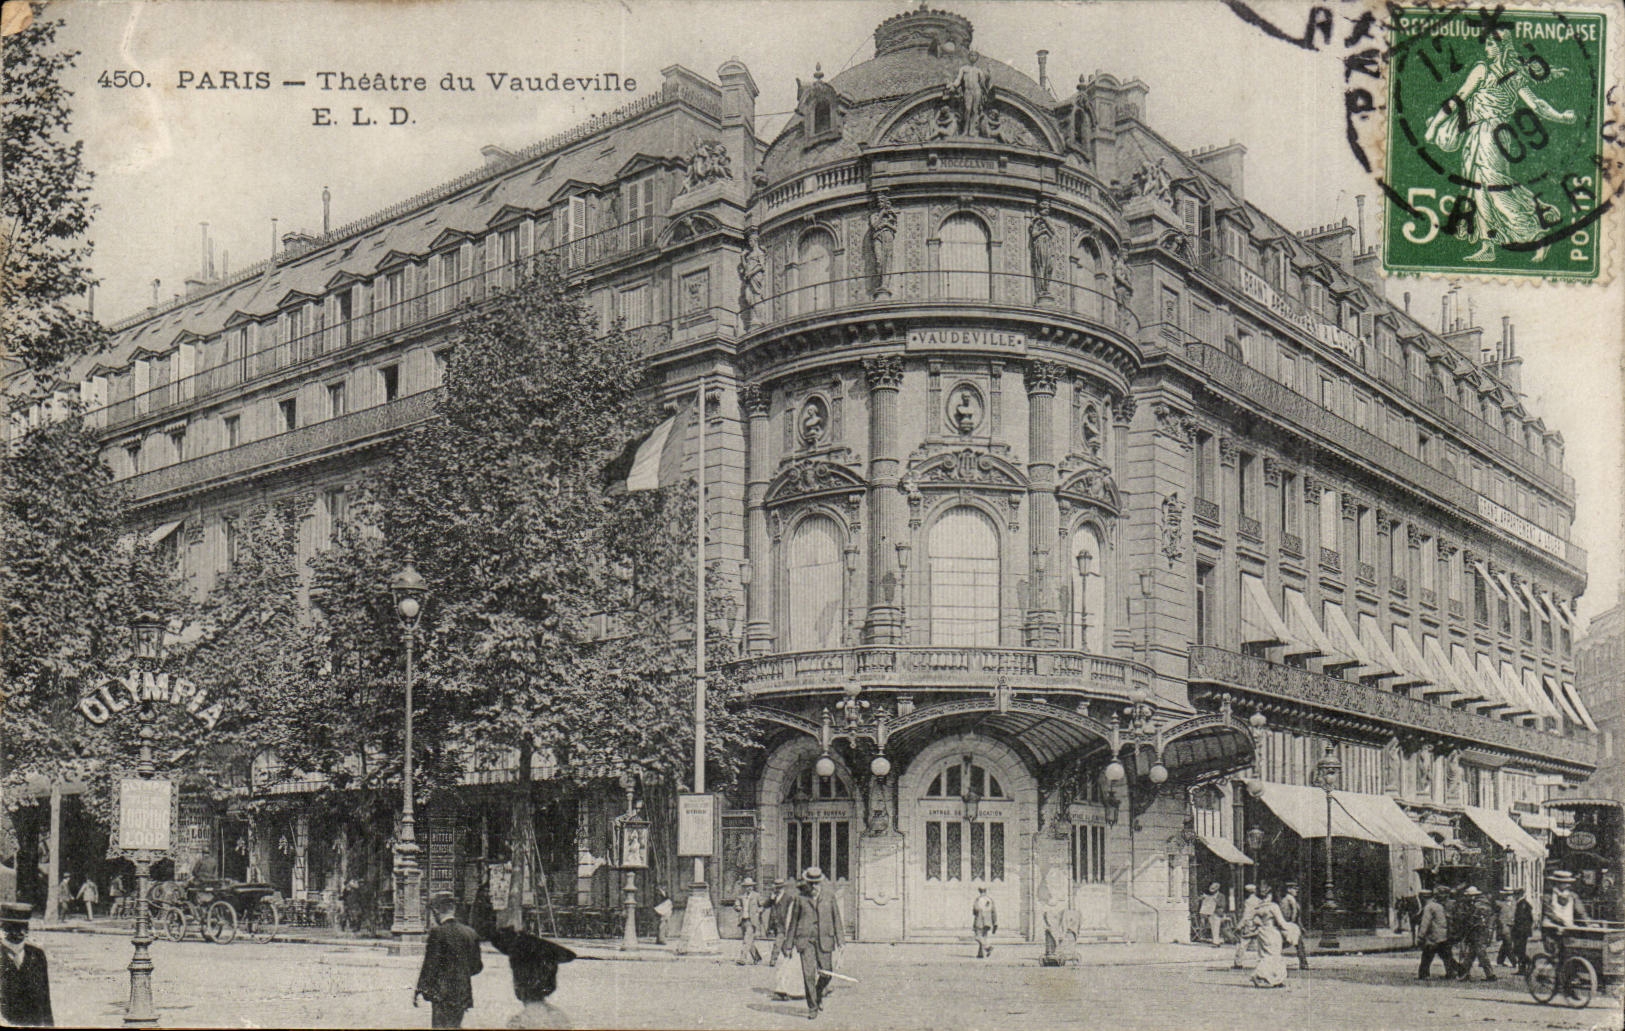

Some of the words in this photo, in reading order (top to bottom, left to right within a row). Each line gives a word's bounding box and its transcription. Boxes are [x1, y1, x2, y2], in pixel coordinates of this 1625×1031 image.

[1400, 17, 1491, 40] REPUBLIQU
[1514, 21, 1597, 43] FRANÇAISE
[917, 331, 1016, 347] VAUDEVILLE
[79, 668, 224, 730] OLYMPIA
